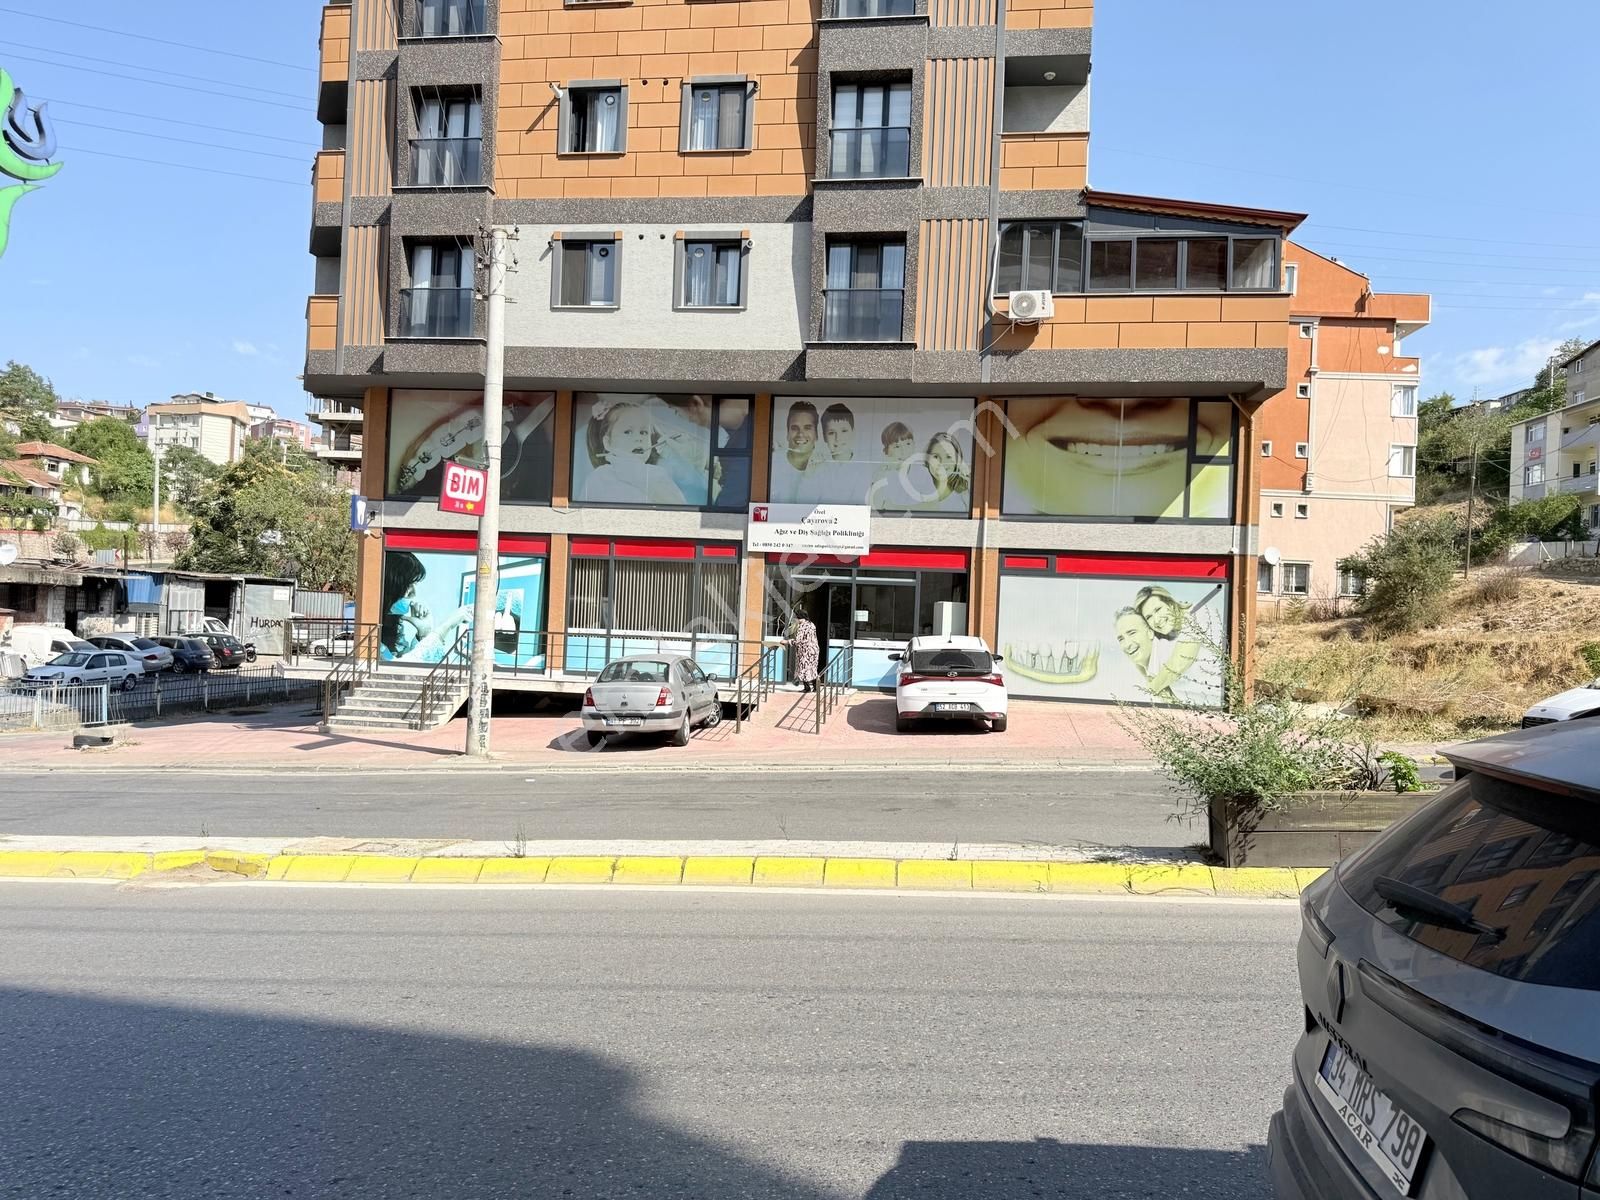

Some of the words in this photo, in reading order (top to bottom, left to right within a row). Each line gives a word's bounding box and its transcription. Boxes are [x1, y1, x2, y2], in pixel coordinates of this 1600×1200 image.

[801, 516, 833, 525] Çayırova
[1331, 1052, 1349, 1091] 34
[1349, 1070, 1382, 1127] MRS
[1380, 1106, 1421, 1170] 798
[1338, 1104, 1374, 1150] ACAR
